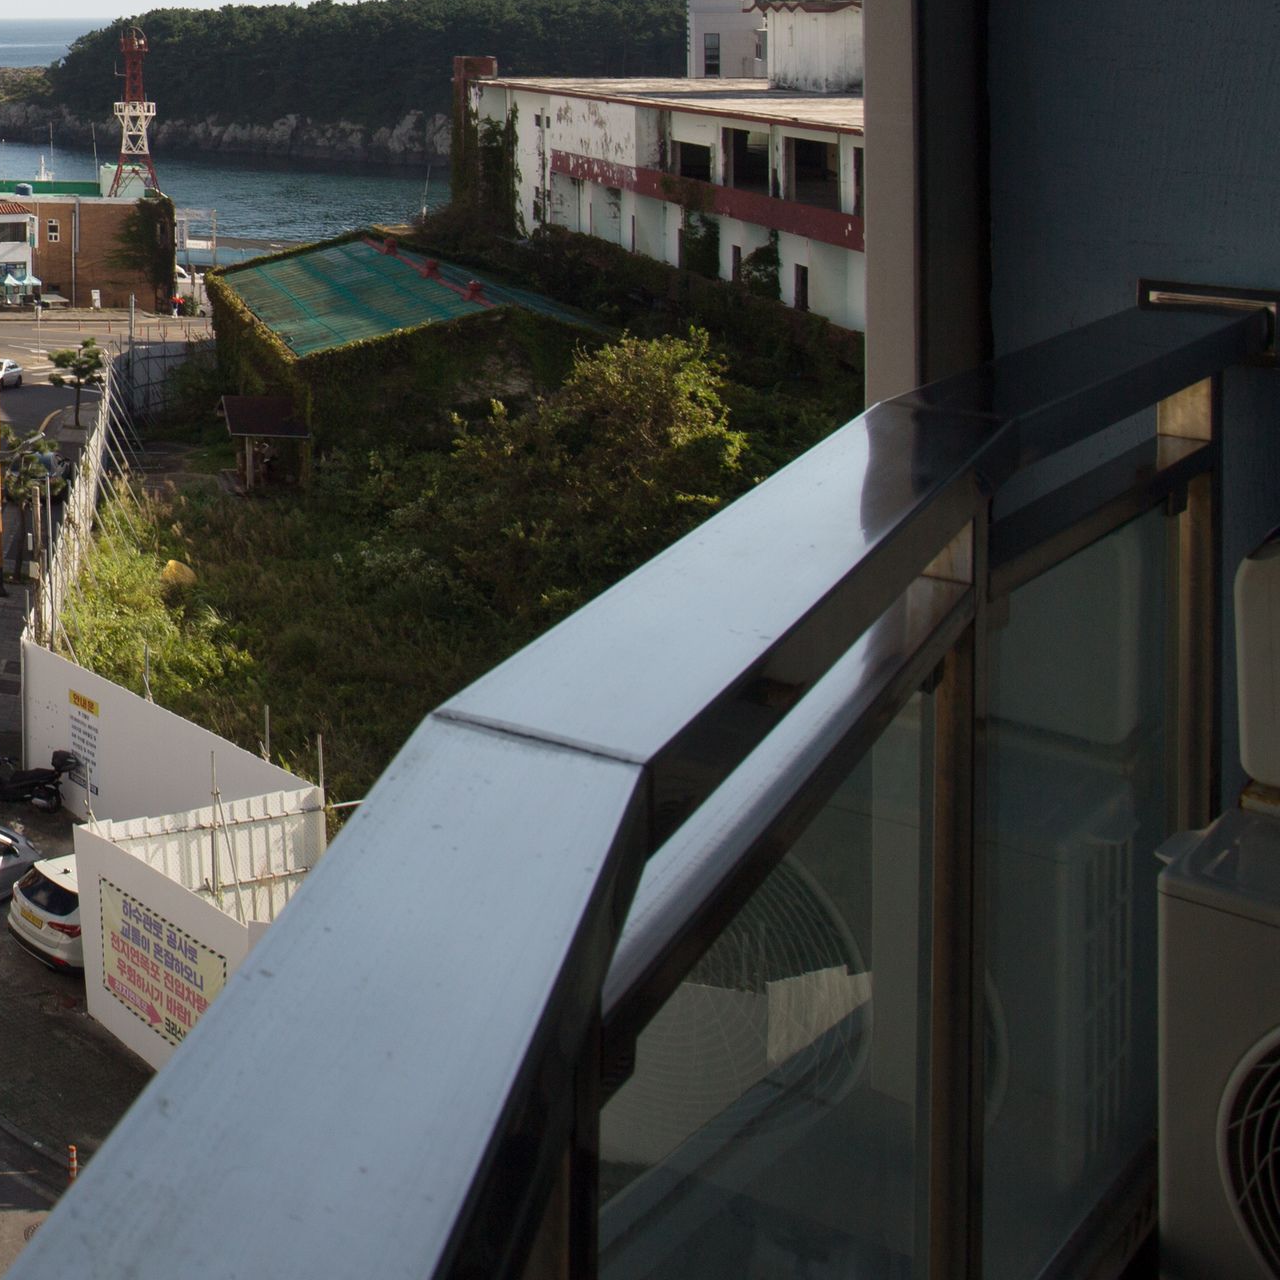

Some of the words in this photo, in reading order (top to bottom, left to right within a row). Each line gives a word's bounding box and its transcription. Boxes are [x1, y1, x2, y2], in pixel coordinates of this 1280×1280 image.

[120, 919, 150, 954] 교통이
[153, 941, 204, 992] 혼잡하오니
[122, 899, 164, 941] 하수관로
[167, 928, 198, 965] 공사로
[116, 957, 163, 1007] 우회하시기
